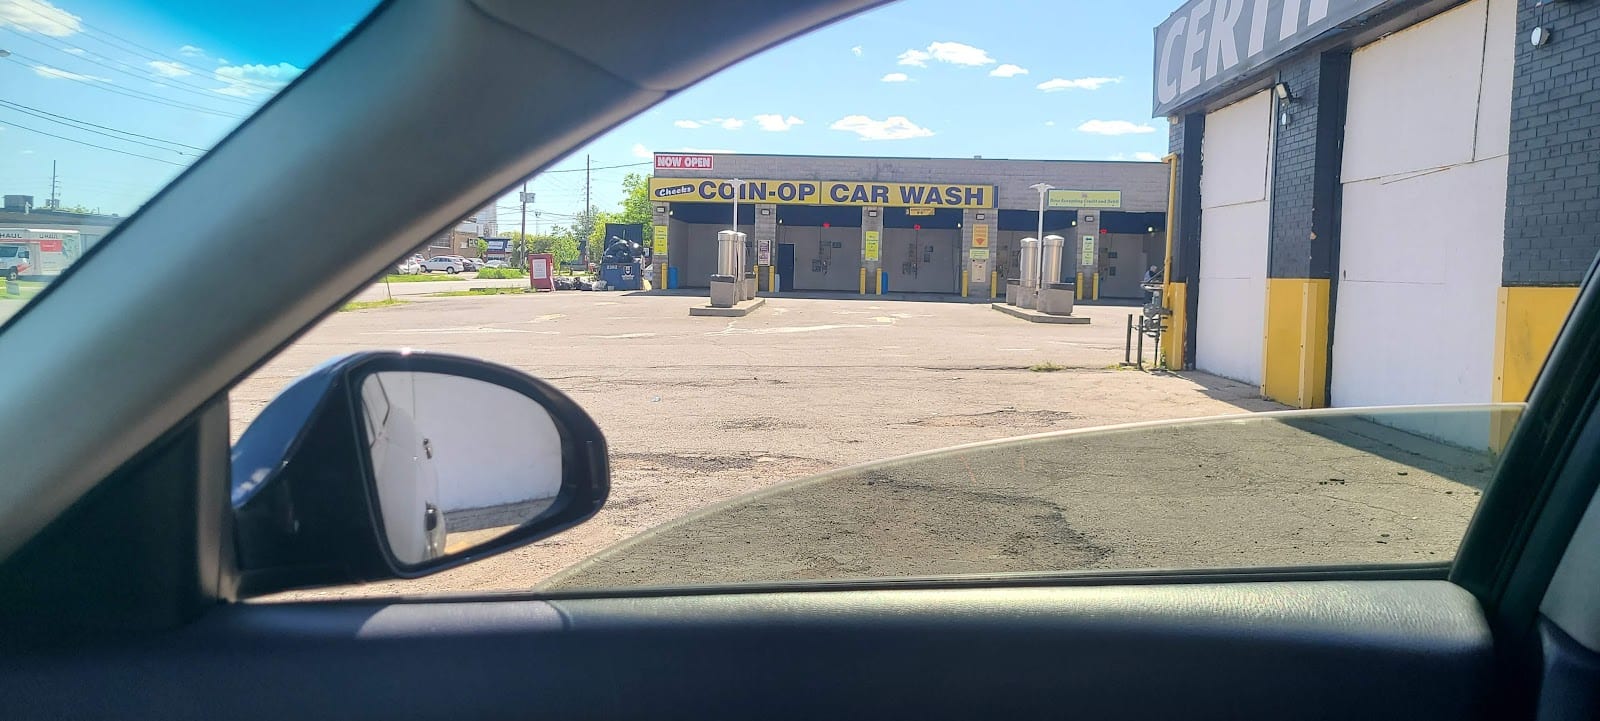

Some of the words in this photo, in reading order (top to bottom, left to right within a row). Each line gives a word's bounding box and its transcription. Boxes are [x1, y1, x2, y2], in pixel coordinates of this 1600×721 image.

[1157, 0, 1329, 104] CERT
[657, 156, 681, 167] NOW
[684, 157, 710, 168] OPEN
[659, 185, 691, 196] Cheeks
[698, 180, 816, 201] COIN-OP
[830, 184, 889, 203] CAR
[900, 185, 984, 206] WASH
